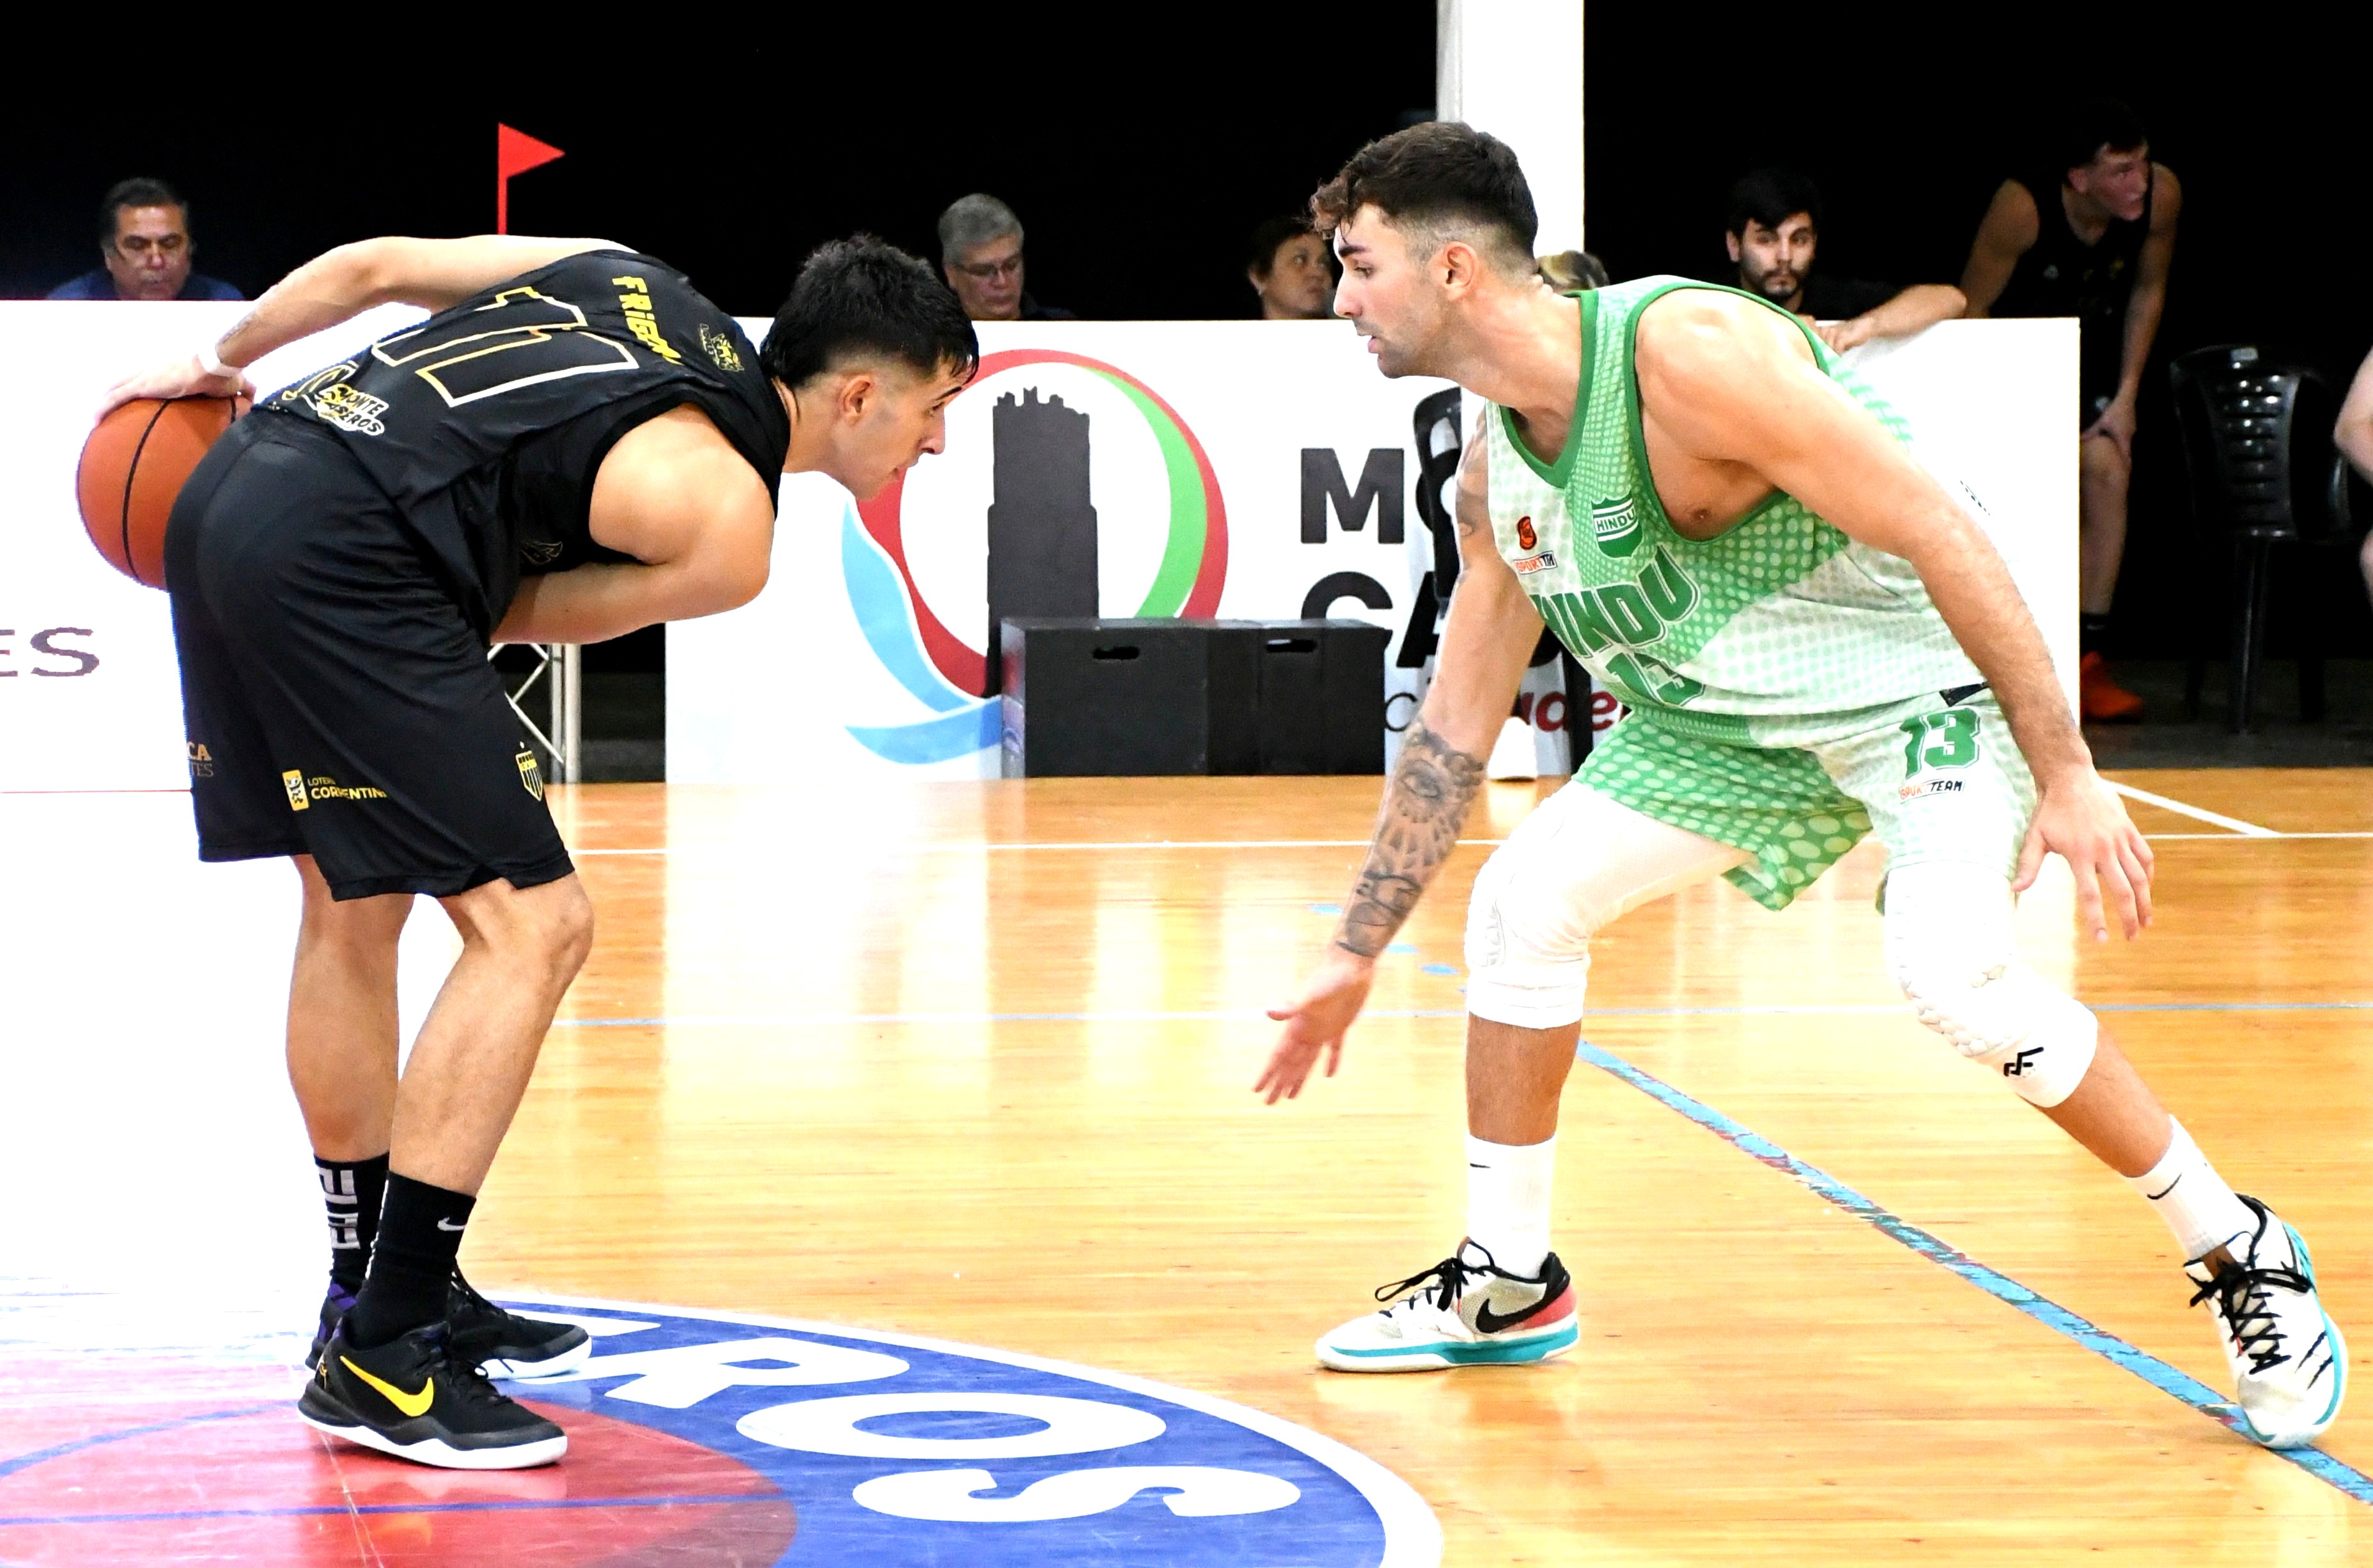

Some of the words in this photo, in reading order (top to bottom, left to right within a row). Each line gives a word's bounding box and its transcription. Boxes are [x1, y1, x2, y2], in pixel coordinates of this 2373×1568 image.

[1597, 508, 1636, 532] HINDU
[1899, 707, 1981, 779] 13
[1929, 780, 1964, 792] TEAM
